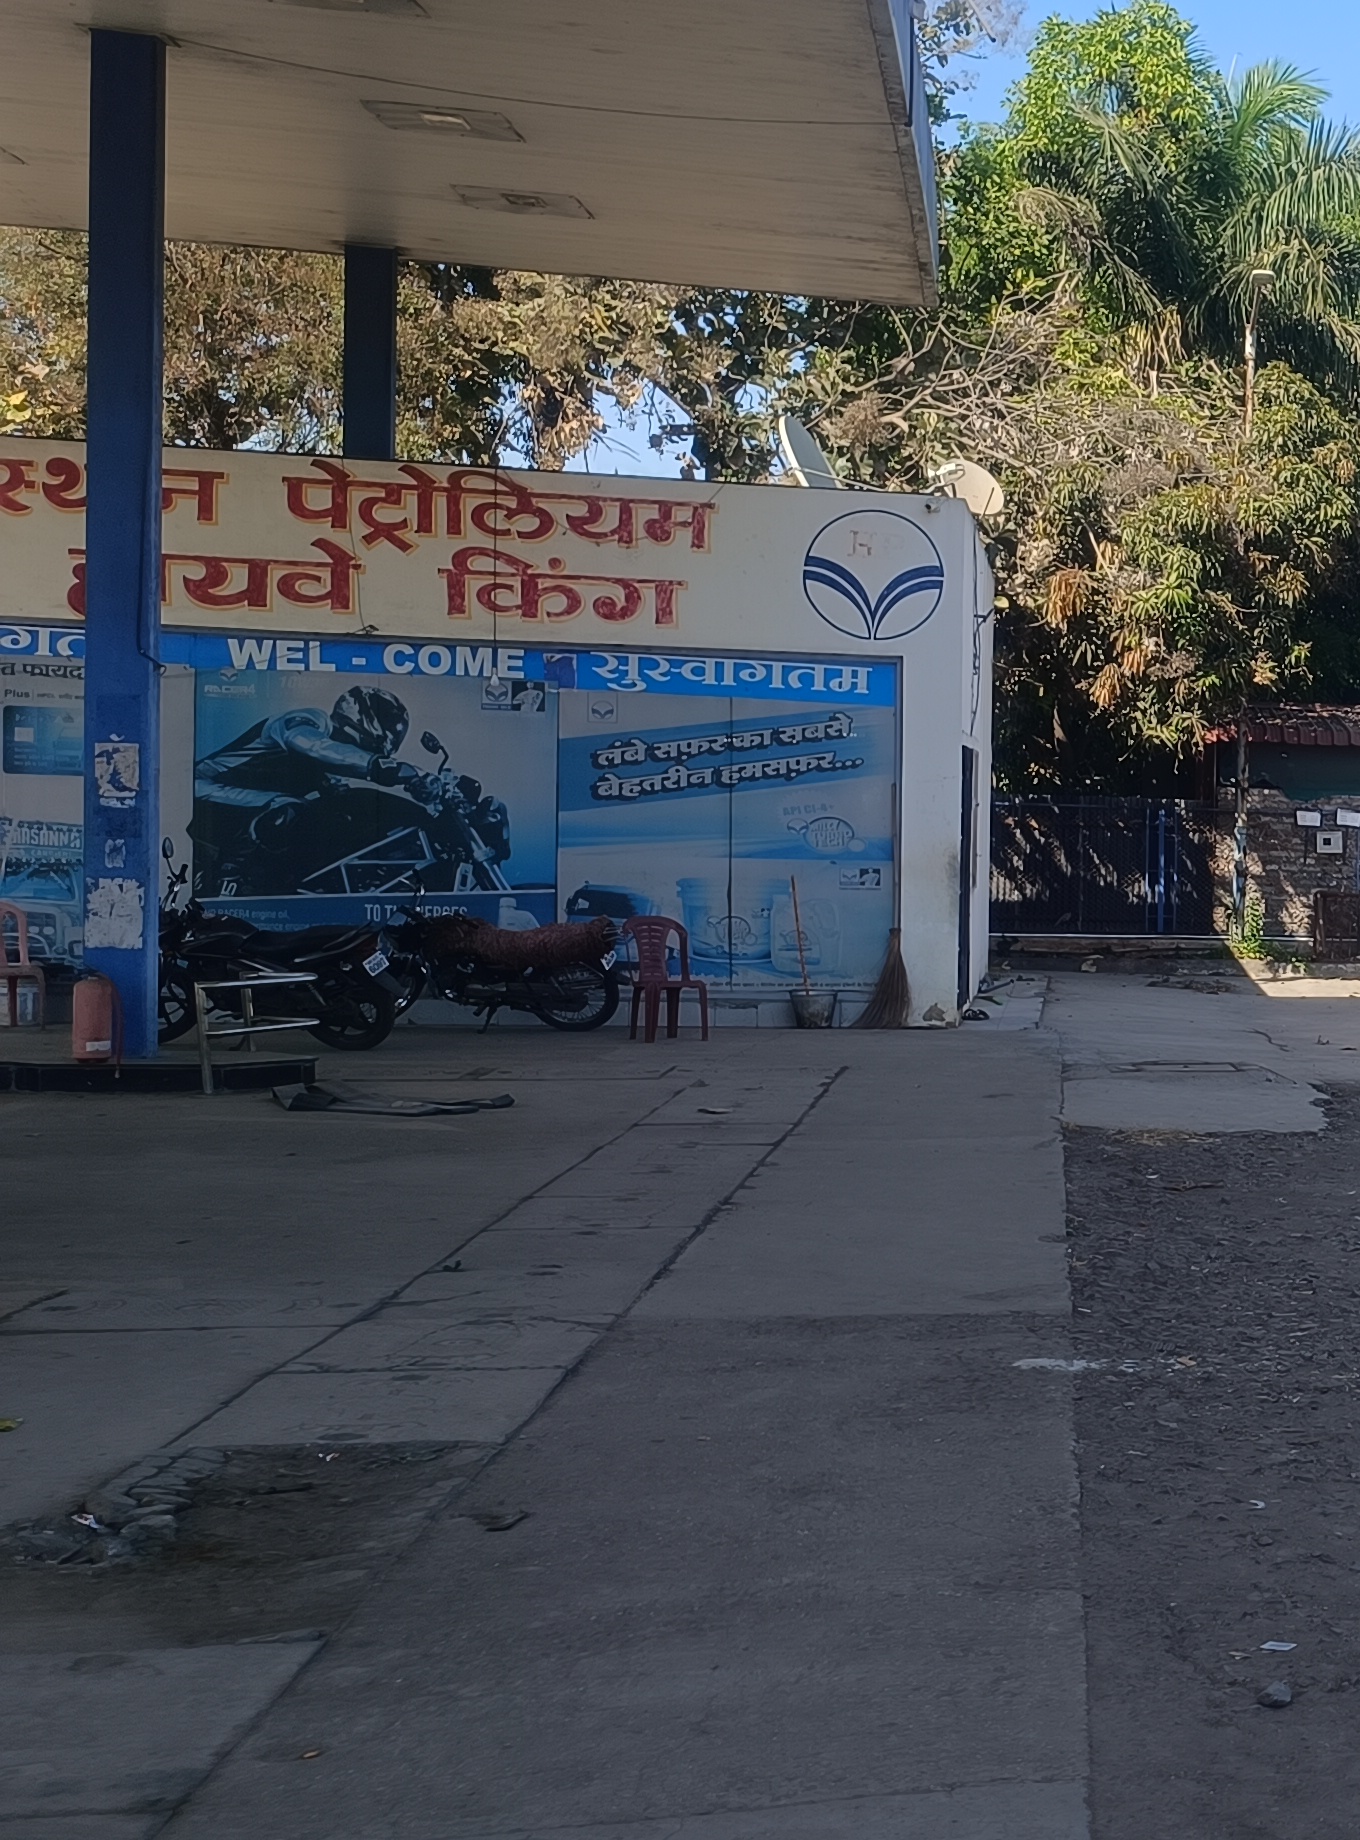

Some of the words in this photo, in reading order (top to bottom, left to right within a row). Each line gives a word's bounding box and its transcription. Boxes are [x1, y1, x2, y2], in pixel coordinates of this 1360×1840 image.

[282, 459, 716, 552] पेट्रोलियम
[438, 546, 687, 626] किंग
[228, 639, 336, 672] WEL
[383, 645, 525, 678] COME
[591, 652, 873, 694] सुस्वागतम
[4, 688, 31, 699] Plus
[597, 740, 647, 766] लंबे
[729, 729, 774, 750] का
[597, 765, 715, 798] बेहतरीन
